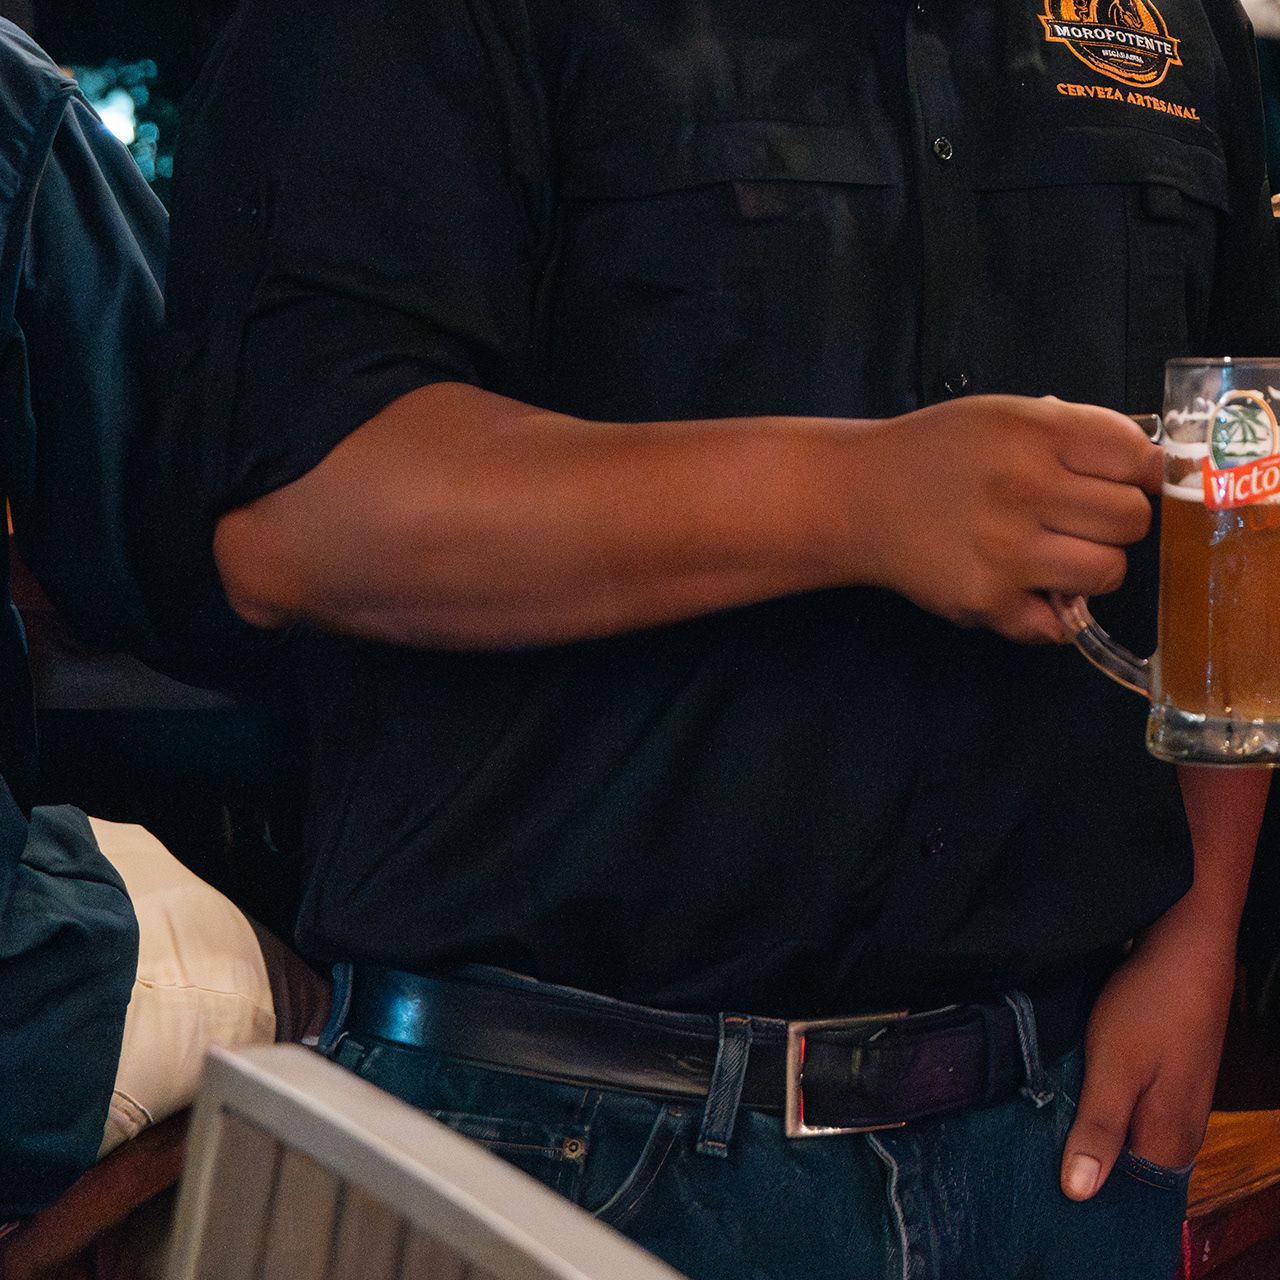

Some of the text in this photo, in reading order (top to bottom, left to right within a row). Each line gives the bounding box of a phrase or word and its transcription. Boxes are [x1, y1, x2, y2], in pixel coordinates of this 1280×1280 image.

[1053, 24, 1173, 56] MOROPOTENTE
[1056, 83, 1200, 121] CERVEZA ARTESANAL
